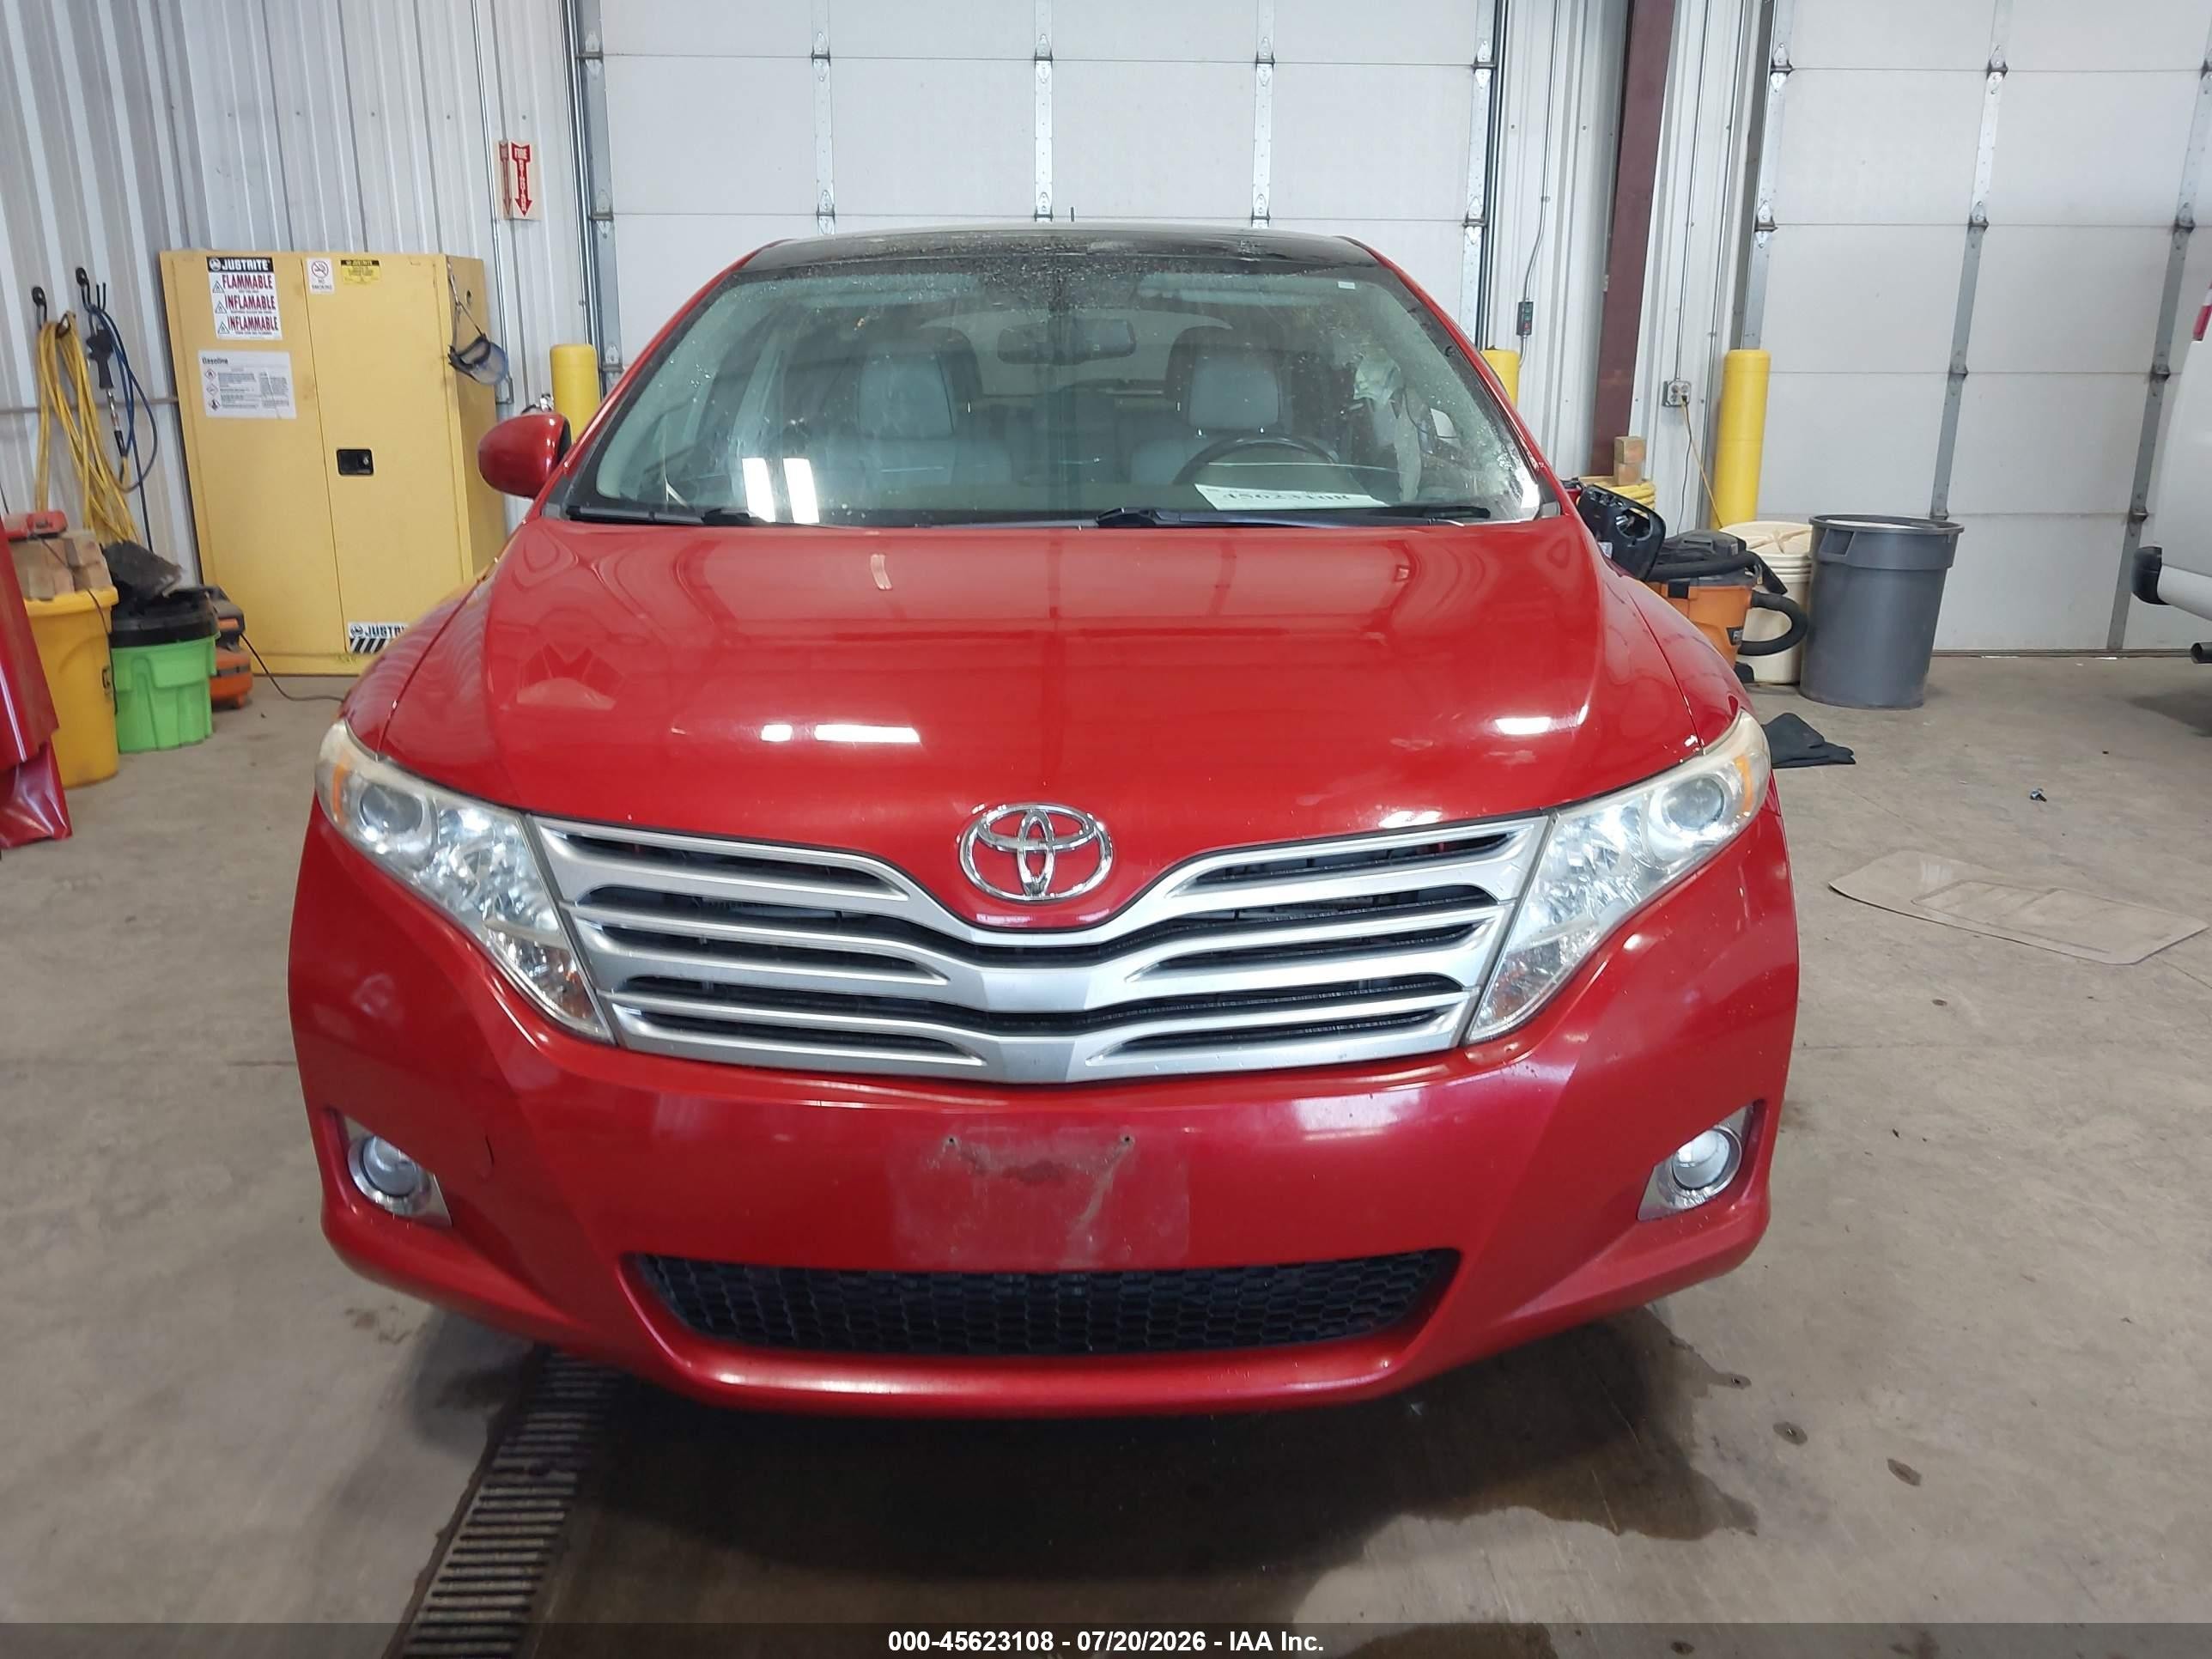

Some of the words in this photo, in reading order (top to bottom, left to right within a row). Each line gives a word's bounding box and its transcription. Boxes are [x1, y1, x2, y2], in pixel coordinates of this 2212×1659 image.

[222, 258, 268, 270] JUSTRITE
[222, 274, 273, 289] FLAMMABLE
[224, 295, 276, 310] INFLAMABLE
[227, 315, 279, 331] INFLAMMABLE
